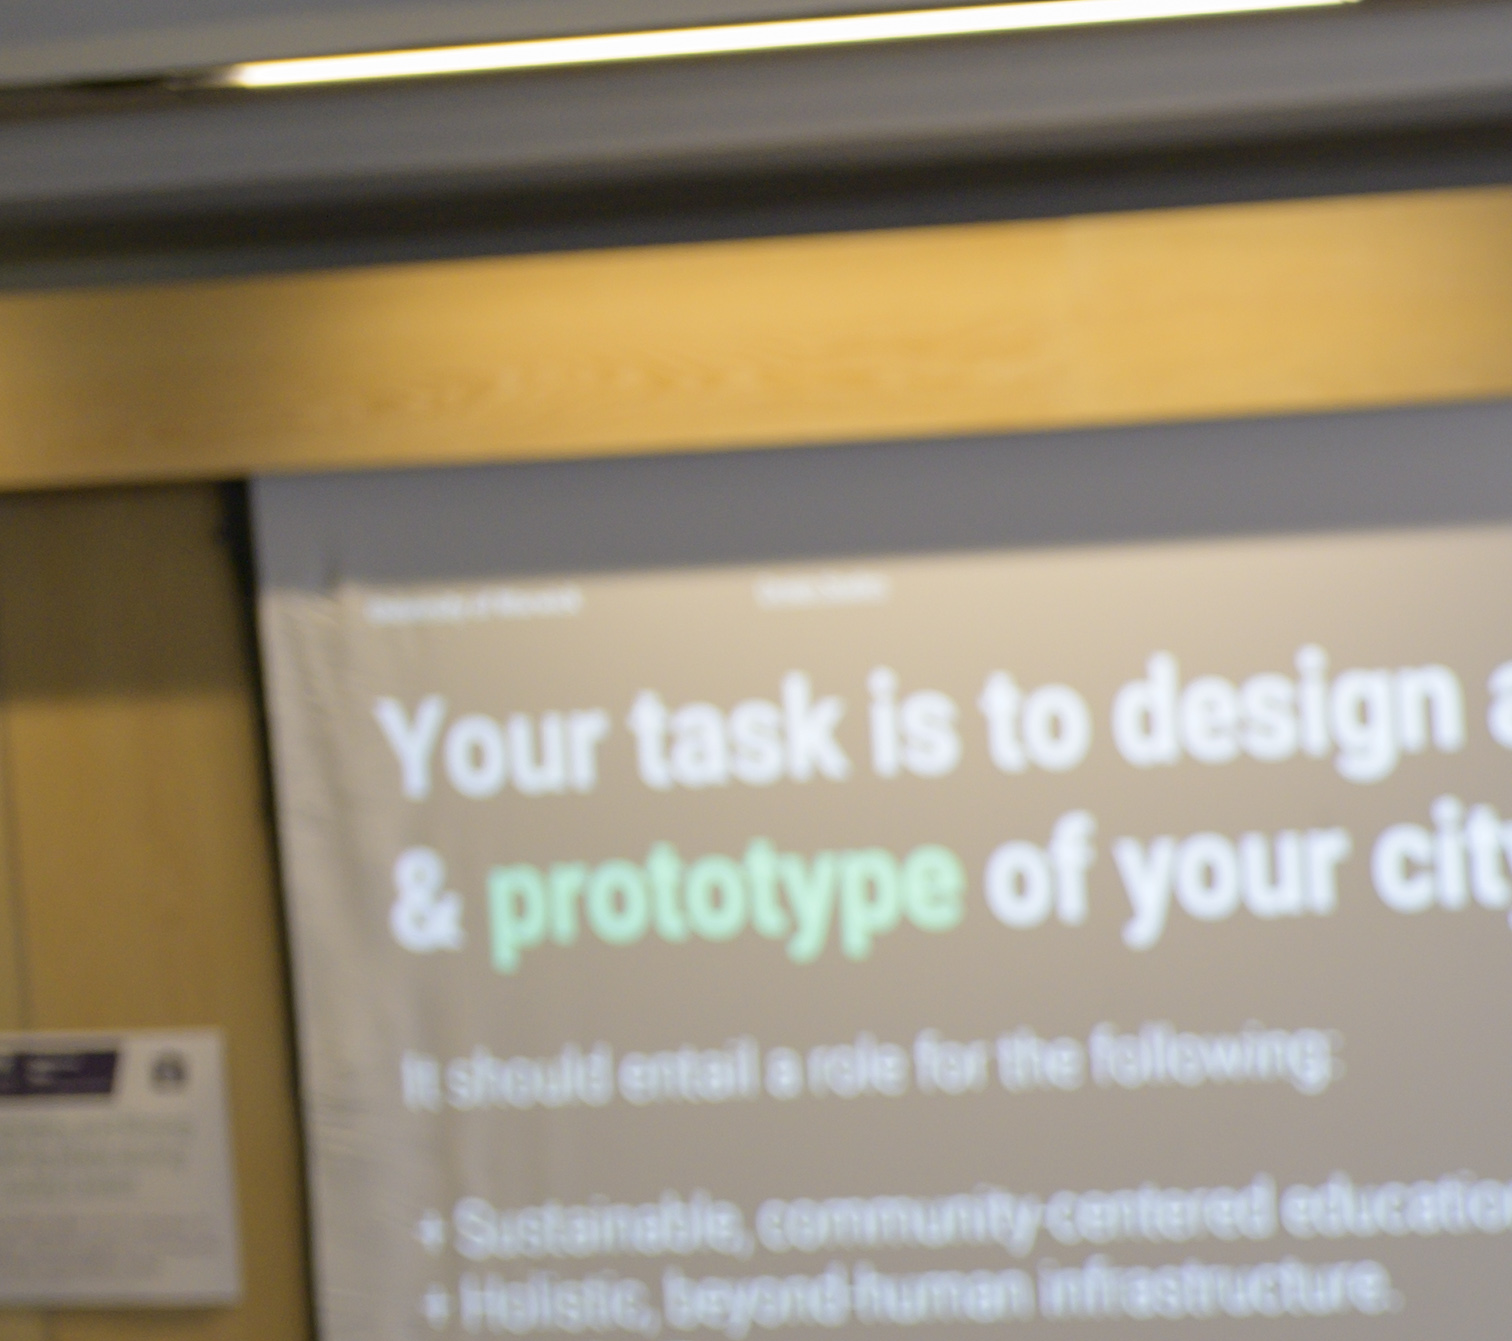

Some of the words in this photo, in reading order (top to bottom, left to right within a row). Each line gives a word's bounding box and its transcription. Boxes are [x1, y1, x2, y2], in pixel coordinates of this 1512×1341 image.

[373, 694, 608, 801] Your
[631, 670, 854, 791] task
[867, 663, 960, 780] is
[980, 668, 1090, 772] to
[1112, 644, 1465, 783] design
[388, 845, 465, 951] &
[487, 836, 966, 973] prototype
[984, 810, 1099, 928] of
[1112, 824, 1351, 950] your
[445, 1041, 614, 1110] should
[618, 1035, 761, 1105] entail
[763, 1046, 802, 1100] a
[807, 1031, 908, 1098] role
[914, 1027, 991, 1096] for
[997, 1024, 1086, 1093] the
[1036, 1252, 1405, 1324] infrastructure.
